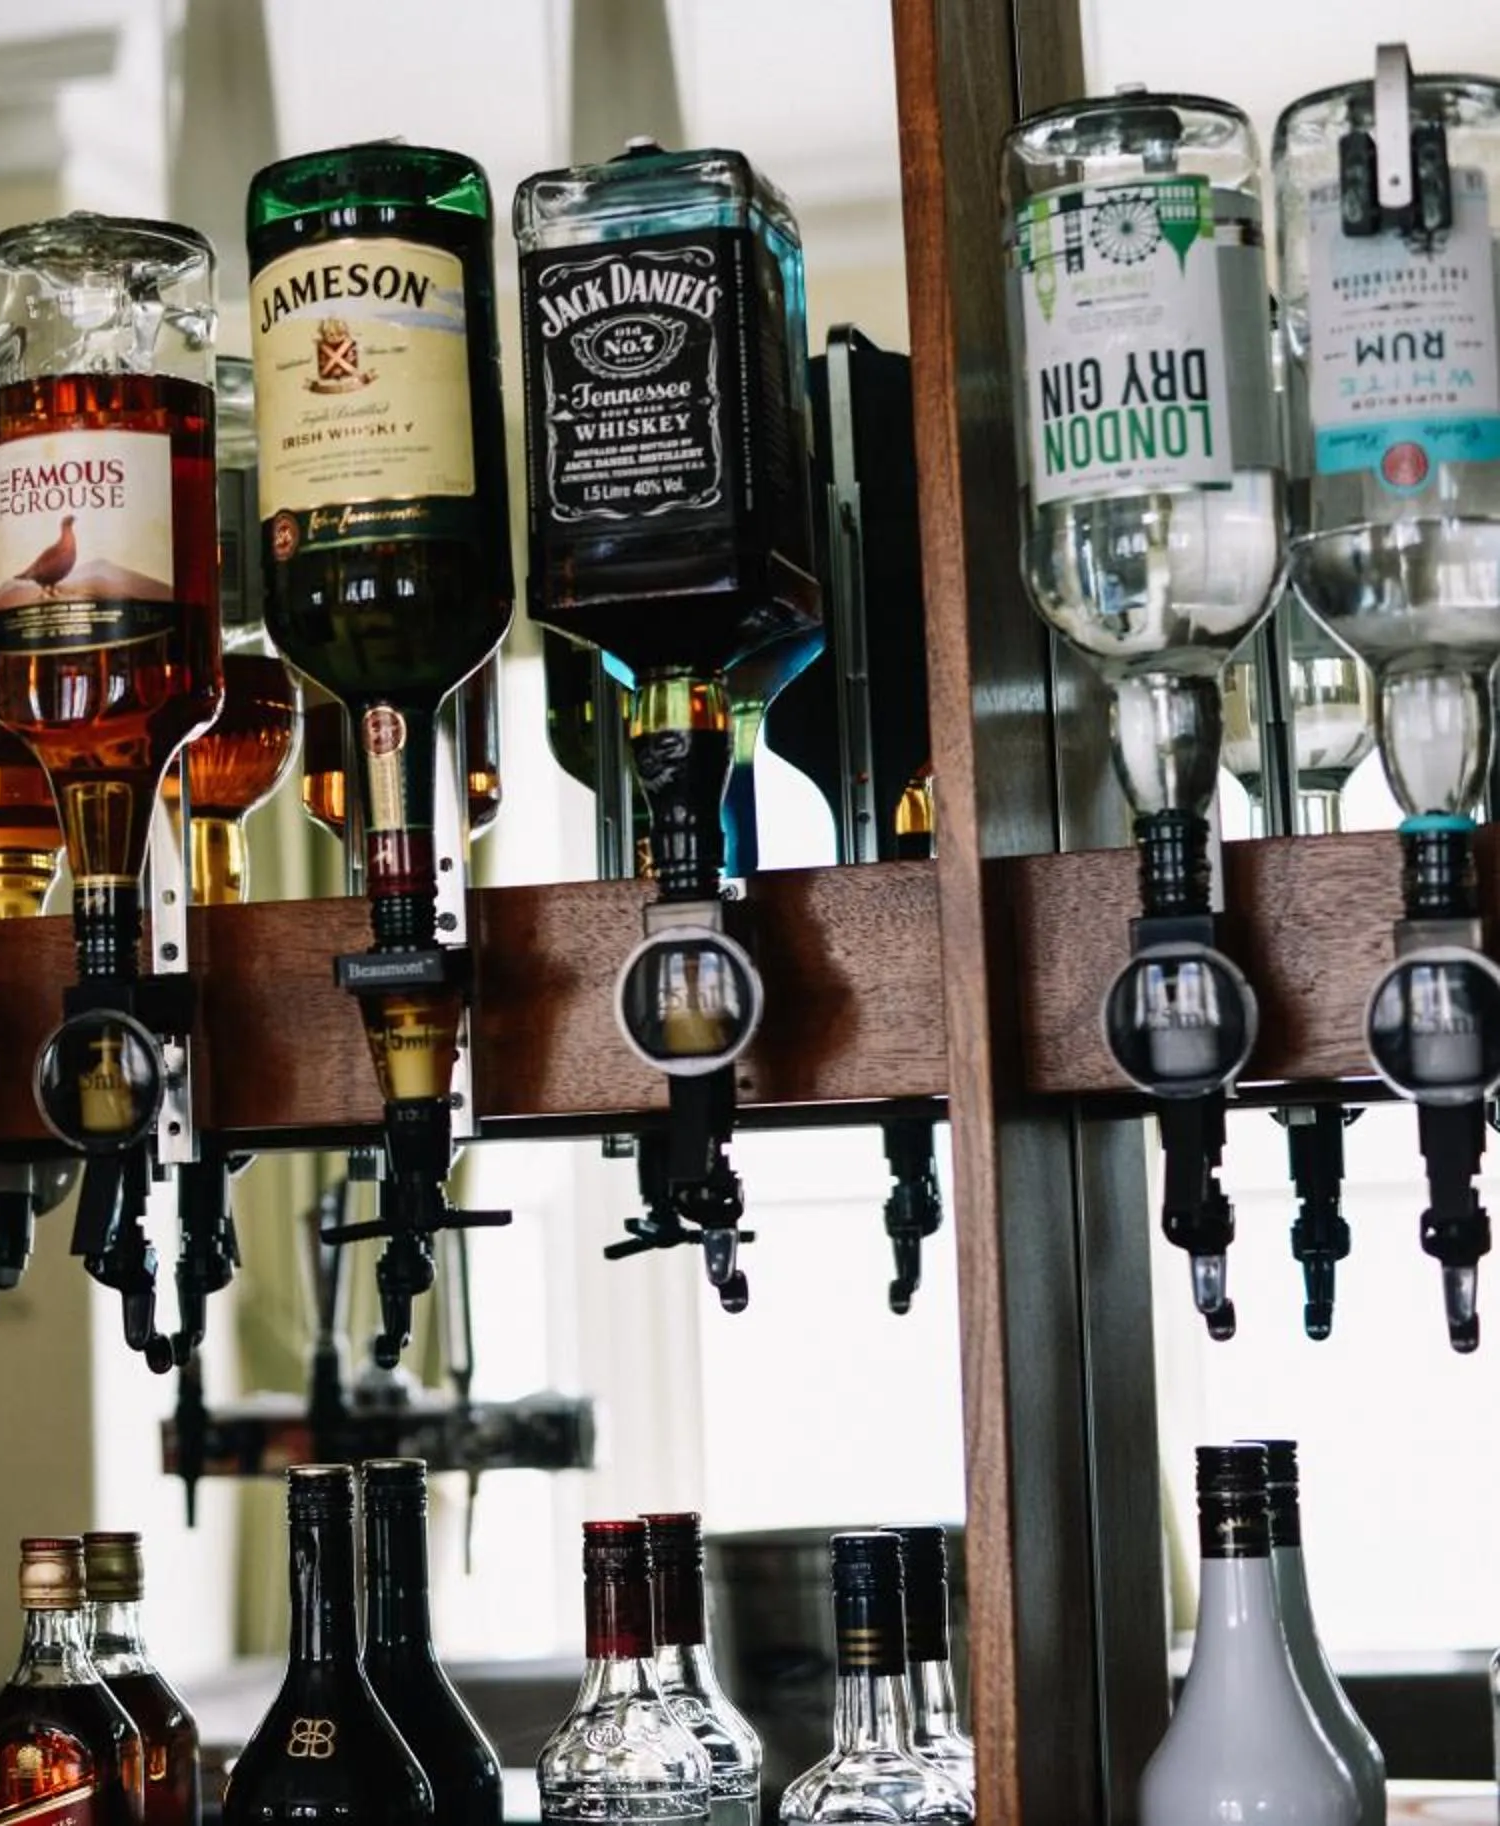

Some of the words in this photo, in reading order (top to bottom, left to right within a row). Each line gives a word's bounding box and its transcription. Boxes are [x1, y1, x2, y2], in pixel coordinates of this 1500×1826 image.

[260, 263, 430, 334] JAMESON
[538, 276, 609, 337] JACK
[610, 263, 723, 319] DANIEL'S
[603, 335, 655, 357] No.7
[1355, 329, 1446, 367] RUM
[1041, 356, 1102, 421] GIN
[1121, 348, 1208, 403] DRY
[1339, 368, 1475, 395] WHITE
[571, 381, 692, 410] Tennessee
[282, 433, 323, 450] IRISH
[575, 413, 691, 443] WHISKEY
[1044, 404, 1214, 476] LONDON
[11, 459, 125, 493] FAMOUS
[10, 485, 125, 516] GROUSE
[349, 960, 425, 978] Beaumont
